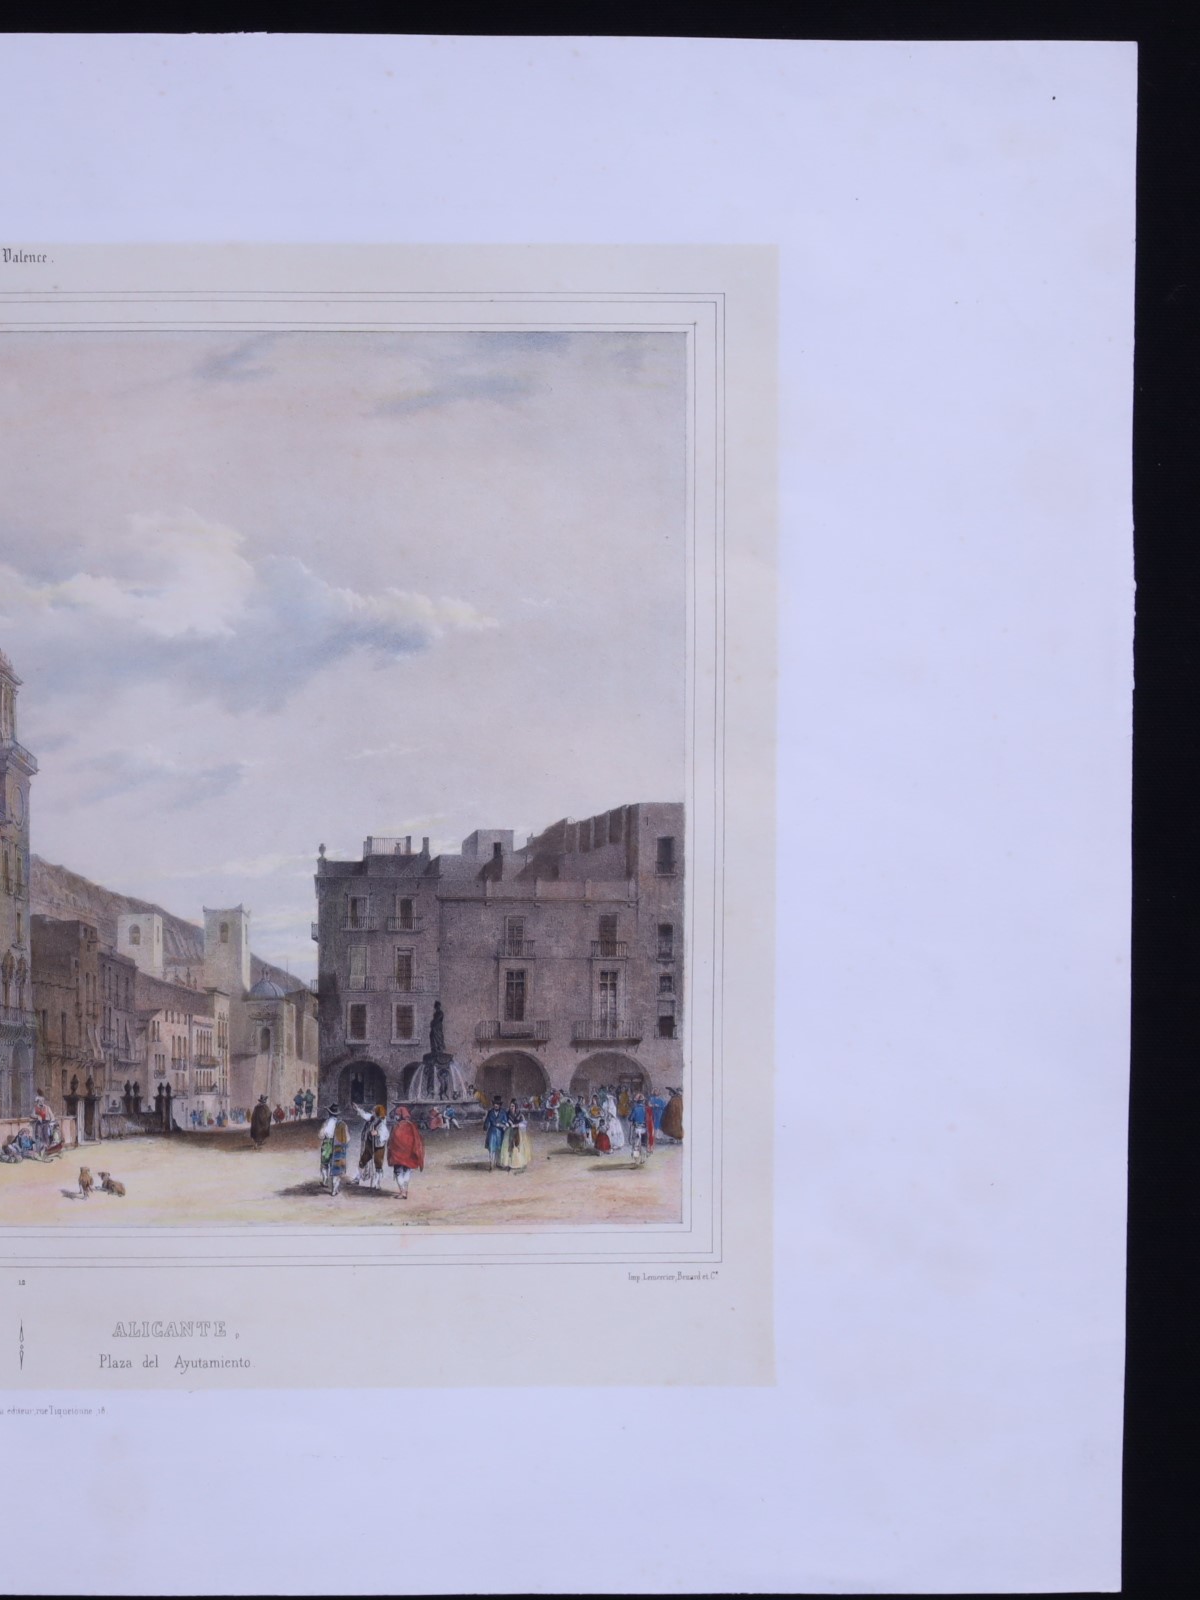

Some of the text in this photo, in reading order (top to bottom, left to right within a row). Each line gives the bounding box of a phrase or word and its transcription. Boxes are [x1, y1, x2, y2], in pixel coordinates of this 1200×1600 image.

[702, 1273, 710, 1281] et
[99, 1353, 133, 1369] Plaza
[142, 1354, 159, 1369] del
